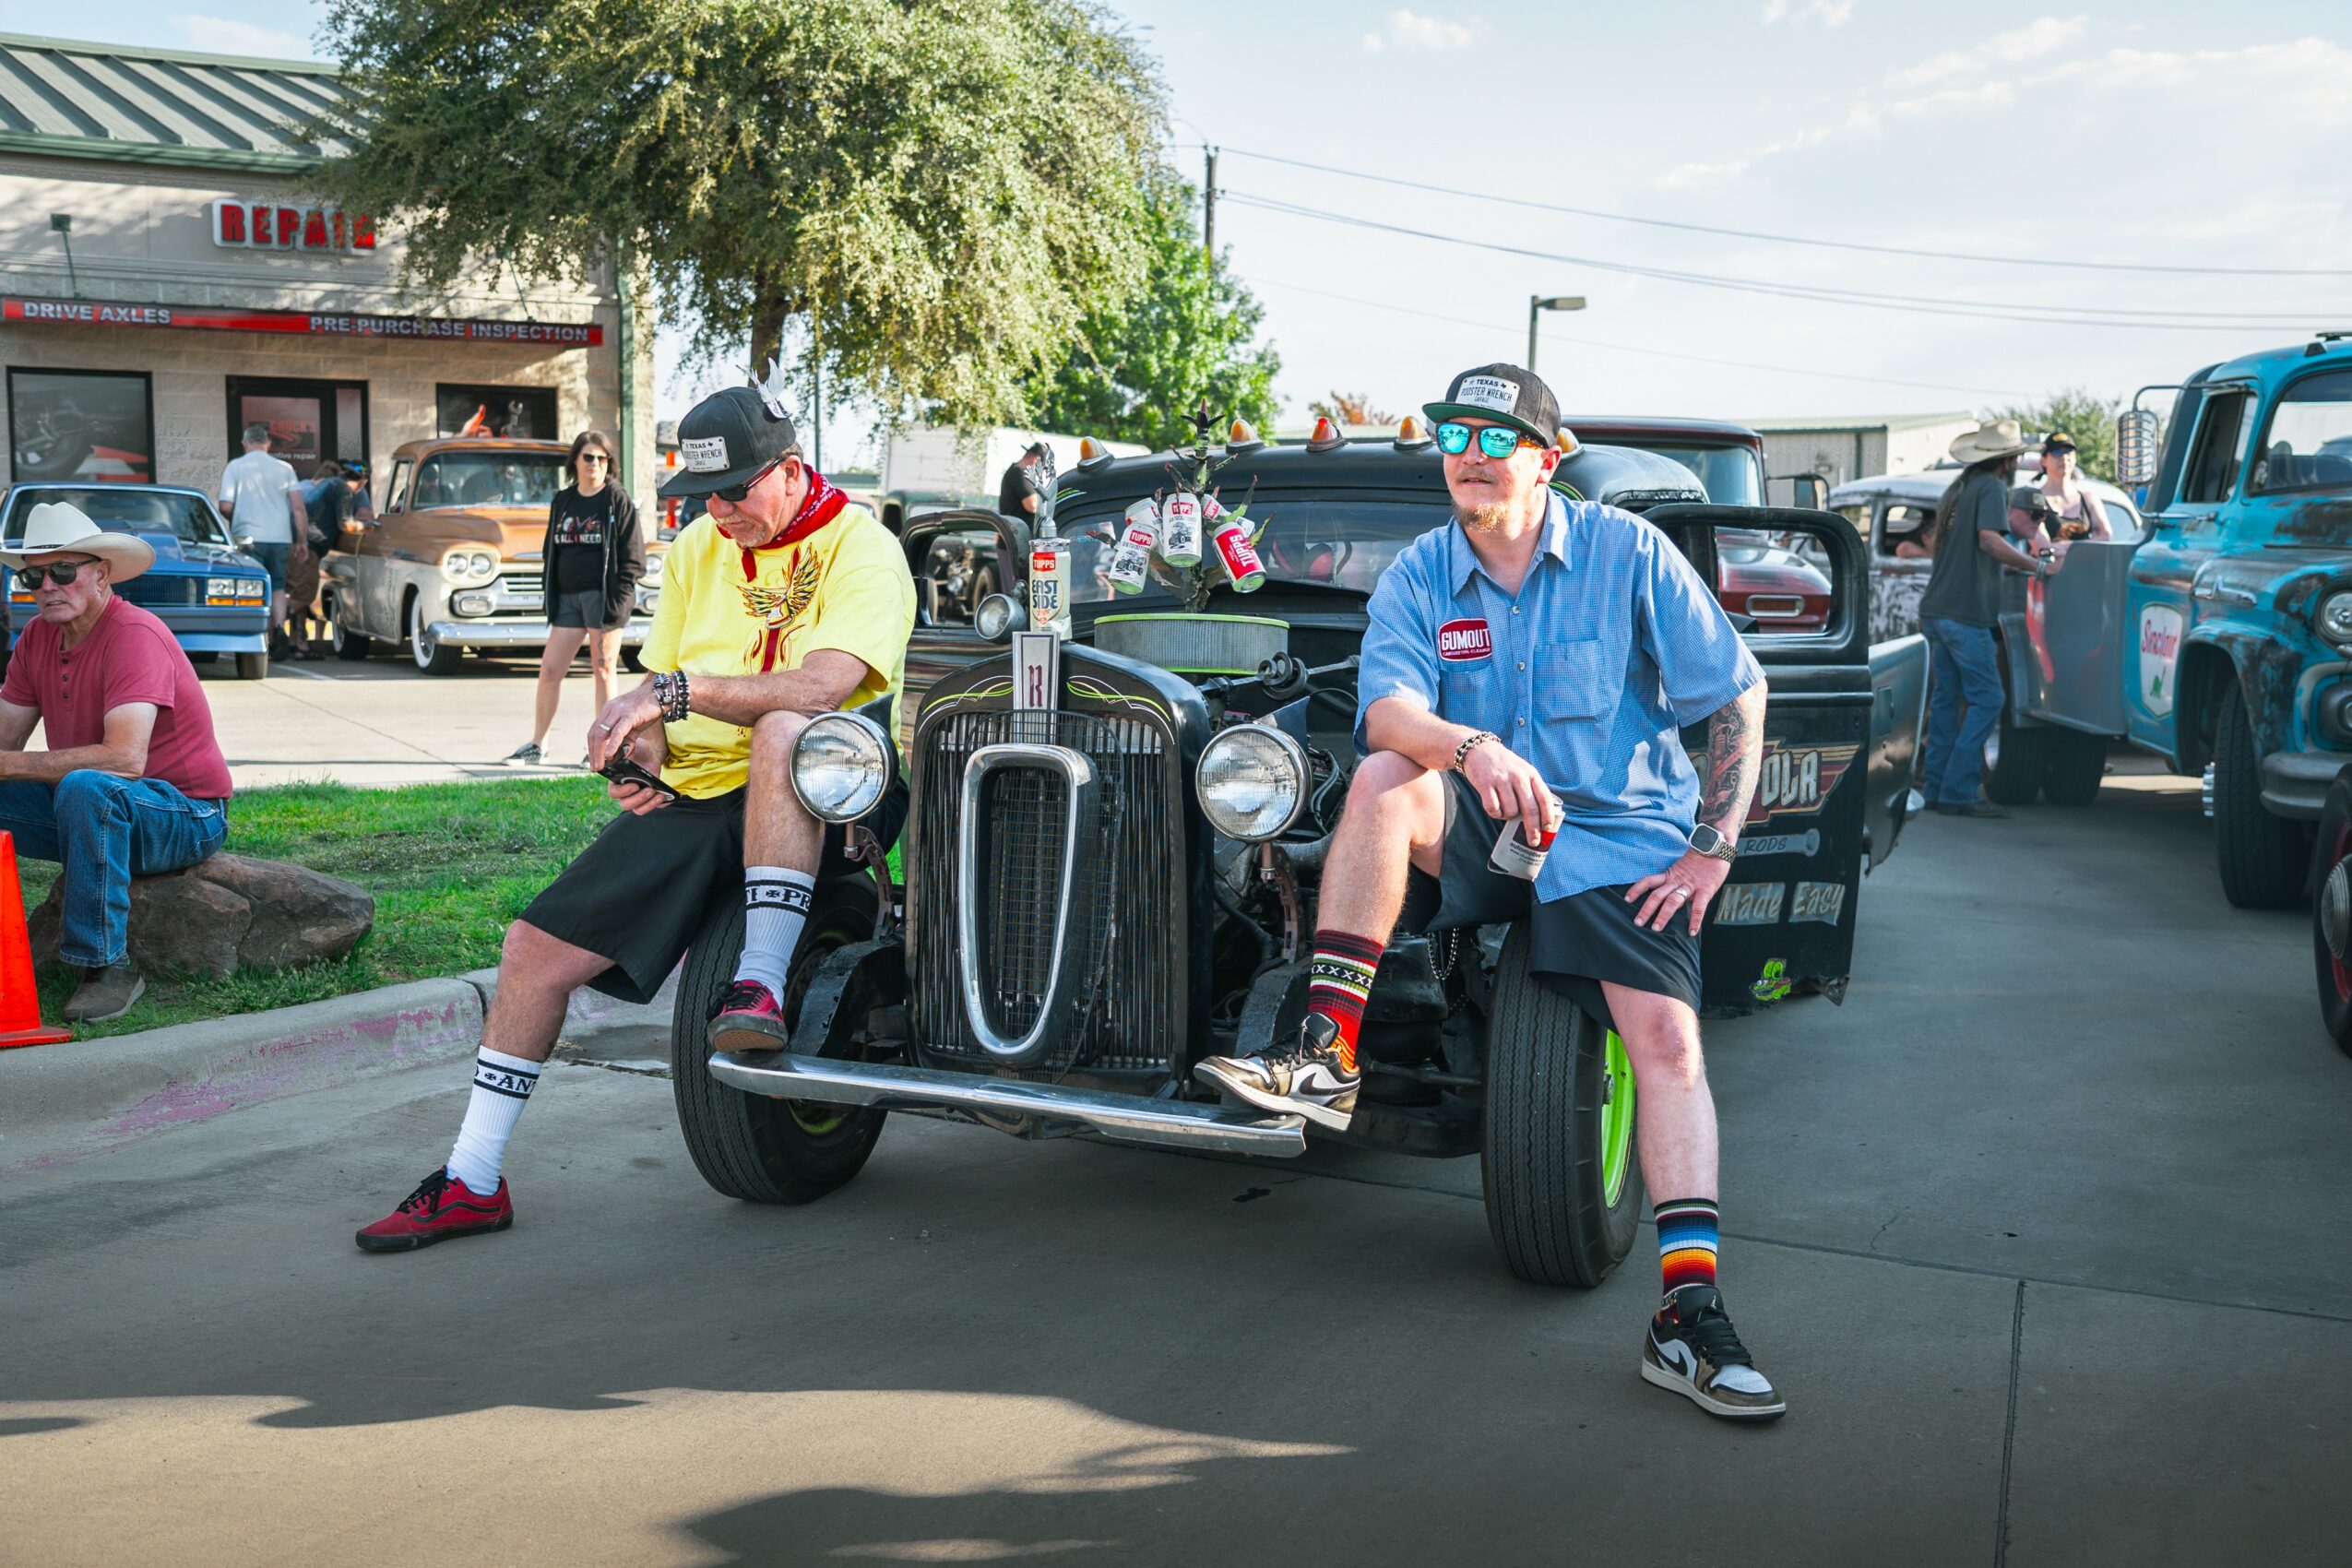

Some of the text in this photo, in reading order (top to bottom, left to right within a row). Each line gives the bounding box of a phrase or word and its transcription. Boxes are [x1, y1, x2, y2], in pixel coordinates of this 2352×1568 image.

[24, 301, 172, 324] DRIVE AXLES
[310, 315, 588, 341] PRE-PURCHASE INSPECTION
[1476, 378, 1499, 387] TEXAS
[1460, 386, 1513, 402] ROOSTER WRENCH
[700, 448, 723, 459] WRENCH
[579, 533, 602, 544] NEED
[1131, 532, 1152, 545] TUPPS
[1229, 534, 1255, 567] TUPPS
[1033, 559, 1055, 569] TUPPS
[1032, 579, 1059, 595] EAST
[1032, 594, 1058, 609] SIDE
[1441, 628, 1491, 651] GUMOUT
[2142, 619, 2178, 659] Sinclair
[1744, 837, 1788, 854] RODS
[1716, 882, 1845, 923] Made Easy
